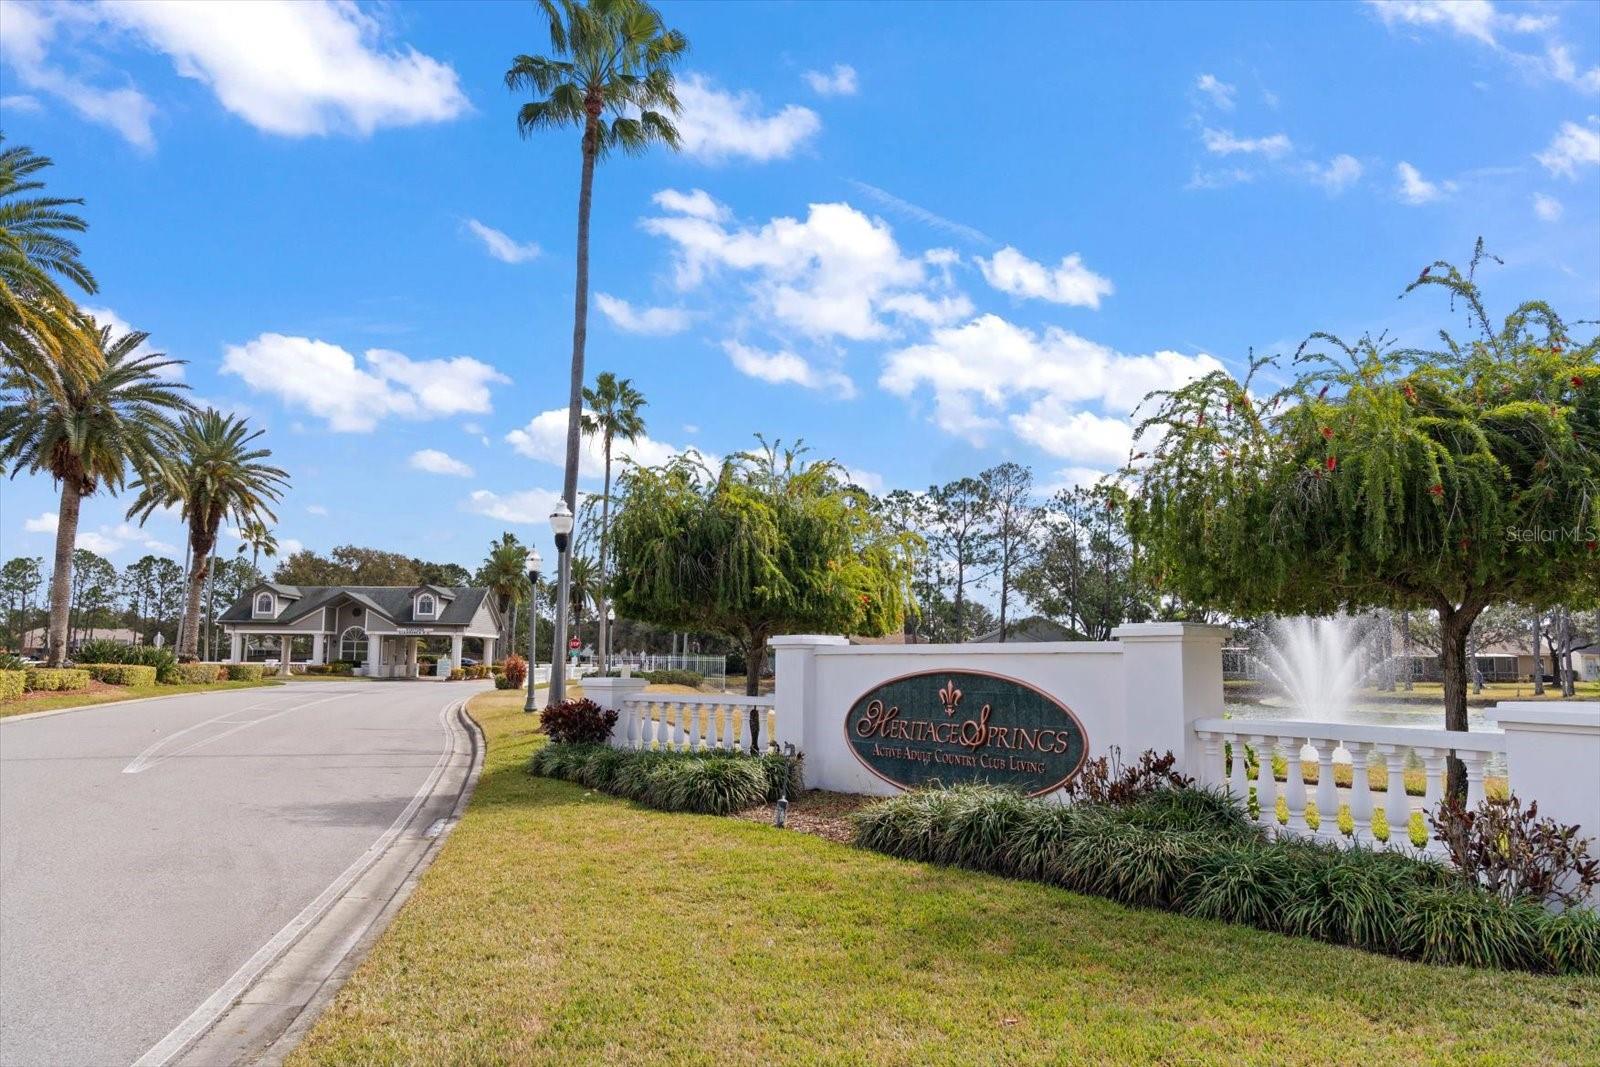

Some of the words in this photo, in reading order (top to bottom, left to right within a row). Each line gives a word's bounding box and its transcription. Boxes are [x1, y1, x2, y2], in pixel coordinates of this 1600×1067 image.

[856, 699, 960, 743] HERITAGE
[959, 704, 1068, 753] SPRINGS
[873, 743, 902, 759] ACTIVE
[934, 749, 977, 767] COUNTRY
[980, 753, 1006, 770] CLUB
[1009, 755, 1045, 774] LIVING
